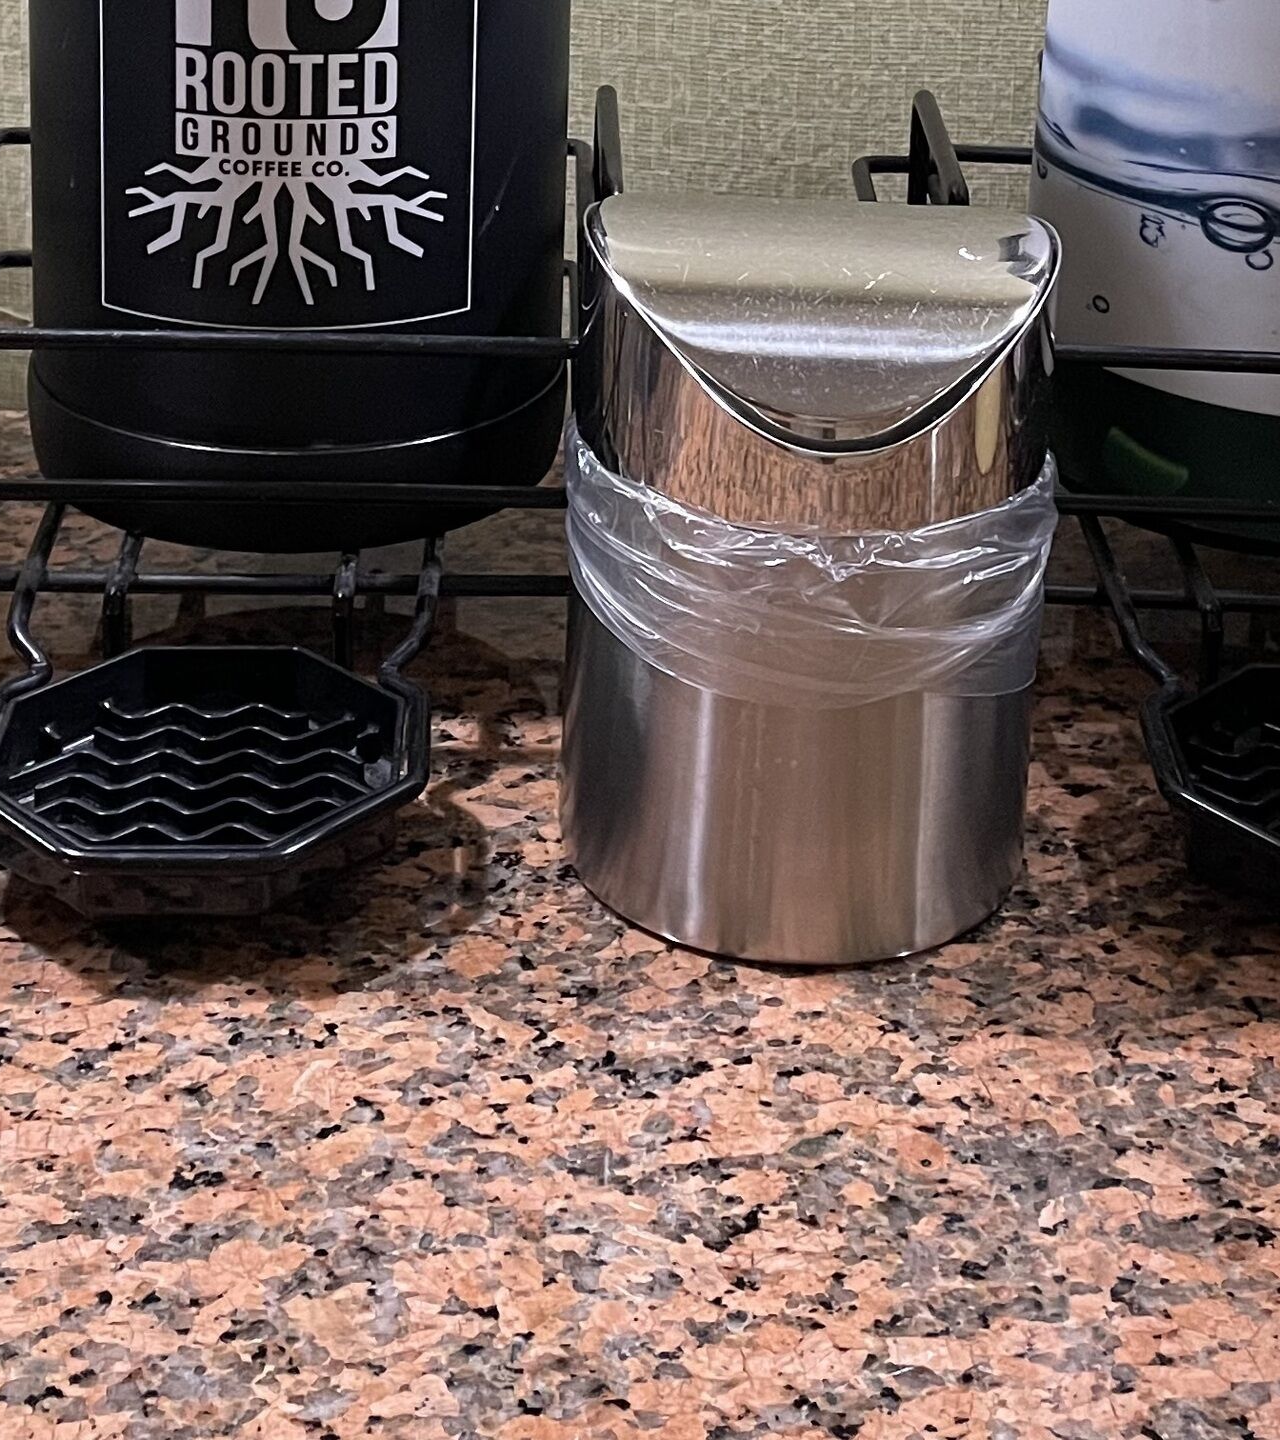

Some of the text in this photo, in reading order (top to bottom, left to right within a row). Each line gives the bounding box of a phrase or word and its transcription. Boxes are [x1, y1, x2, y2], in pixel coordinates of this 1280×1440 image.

[175, 50, 399, 116] ROOTED
[180, 118, 391, 157] GROUNDS
[218, 159, 351, 178] COFFEE CO.
